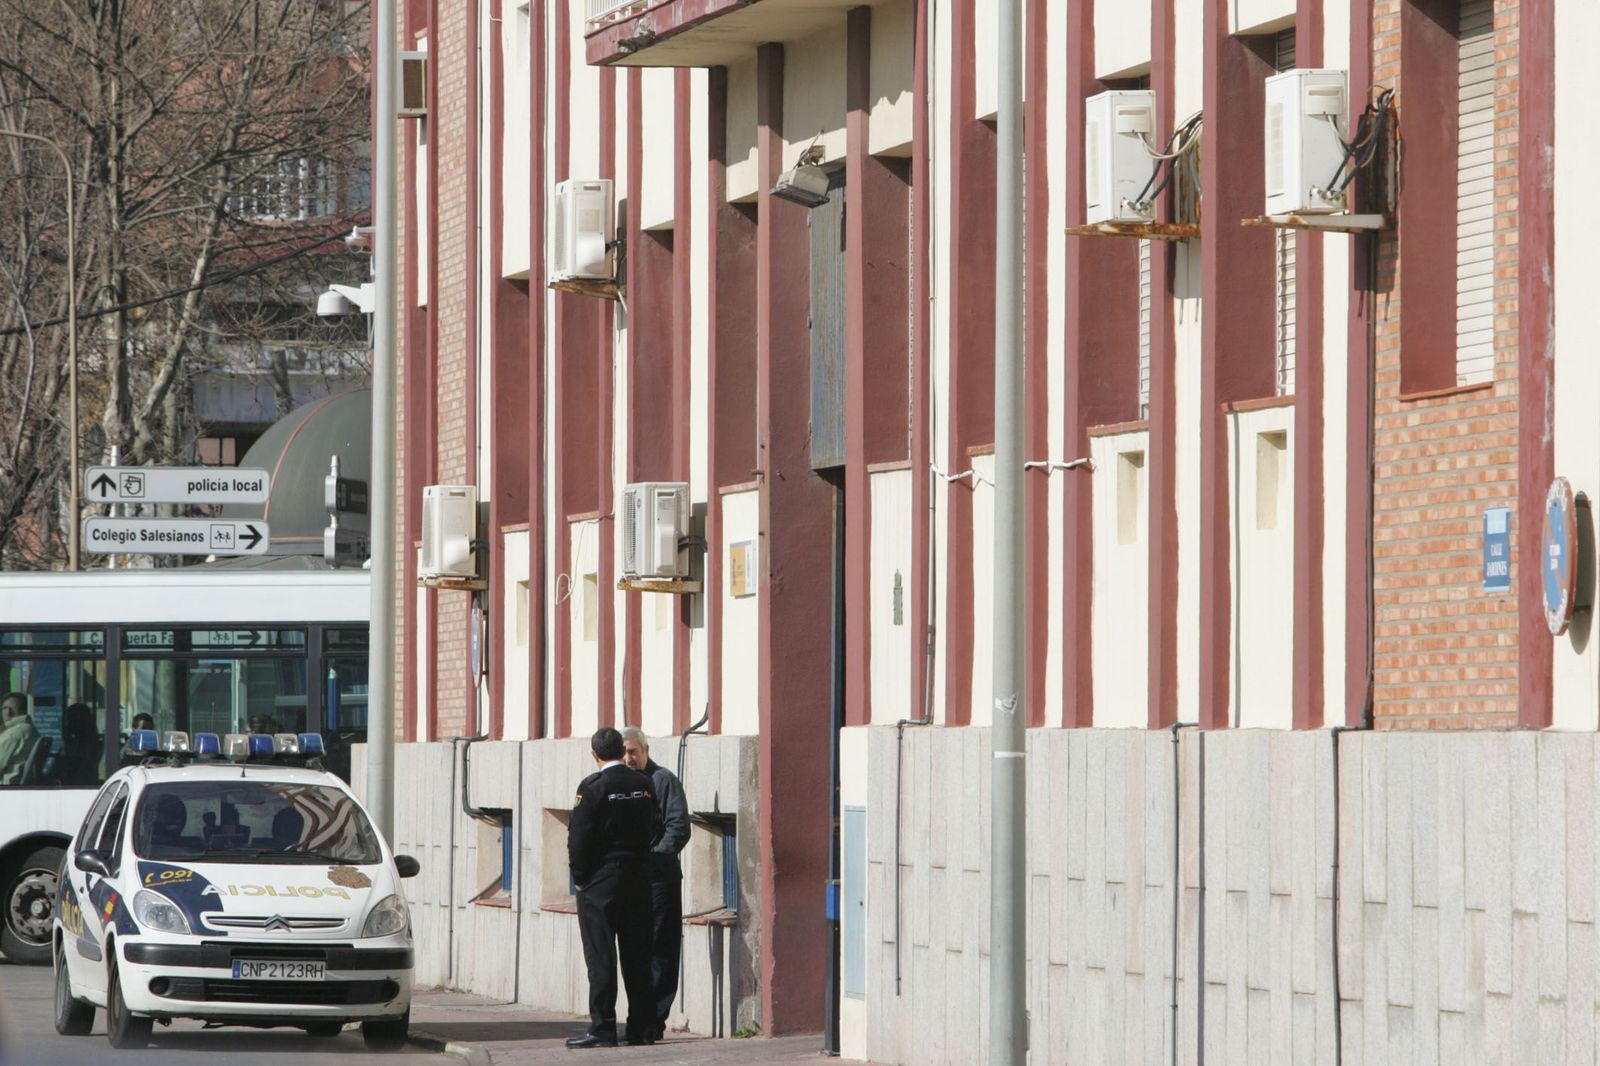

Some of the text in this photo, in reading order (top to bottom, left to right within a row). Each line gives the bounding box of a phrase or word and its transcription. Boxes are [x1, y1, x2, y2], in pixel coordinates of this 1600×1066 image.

[233, 478, 262, 492] local
[92, 528, 204, 544] Colegio Salesianos
[127, 632, 157, 644] uerta
[608, 790, 651, 801] POLICIA
[160, 869, 193, 879] 091
[240, 962, 324, 979] CNP2123RH
